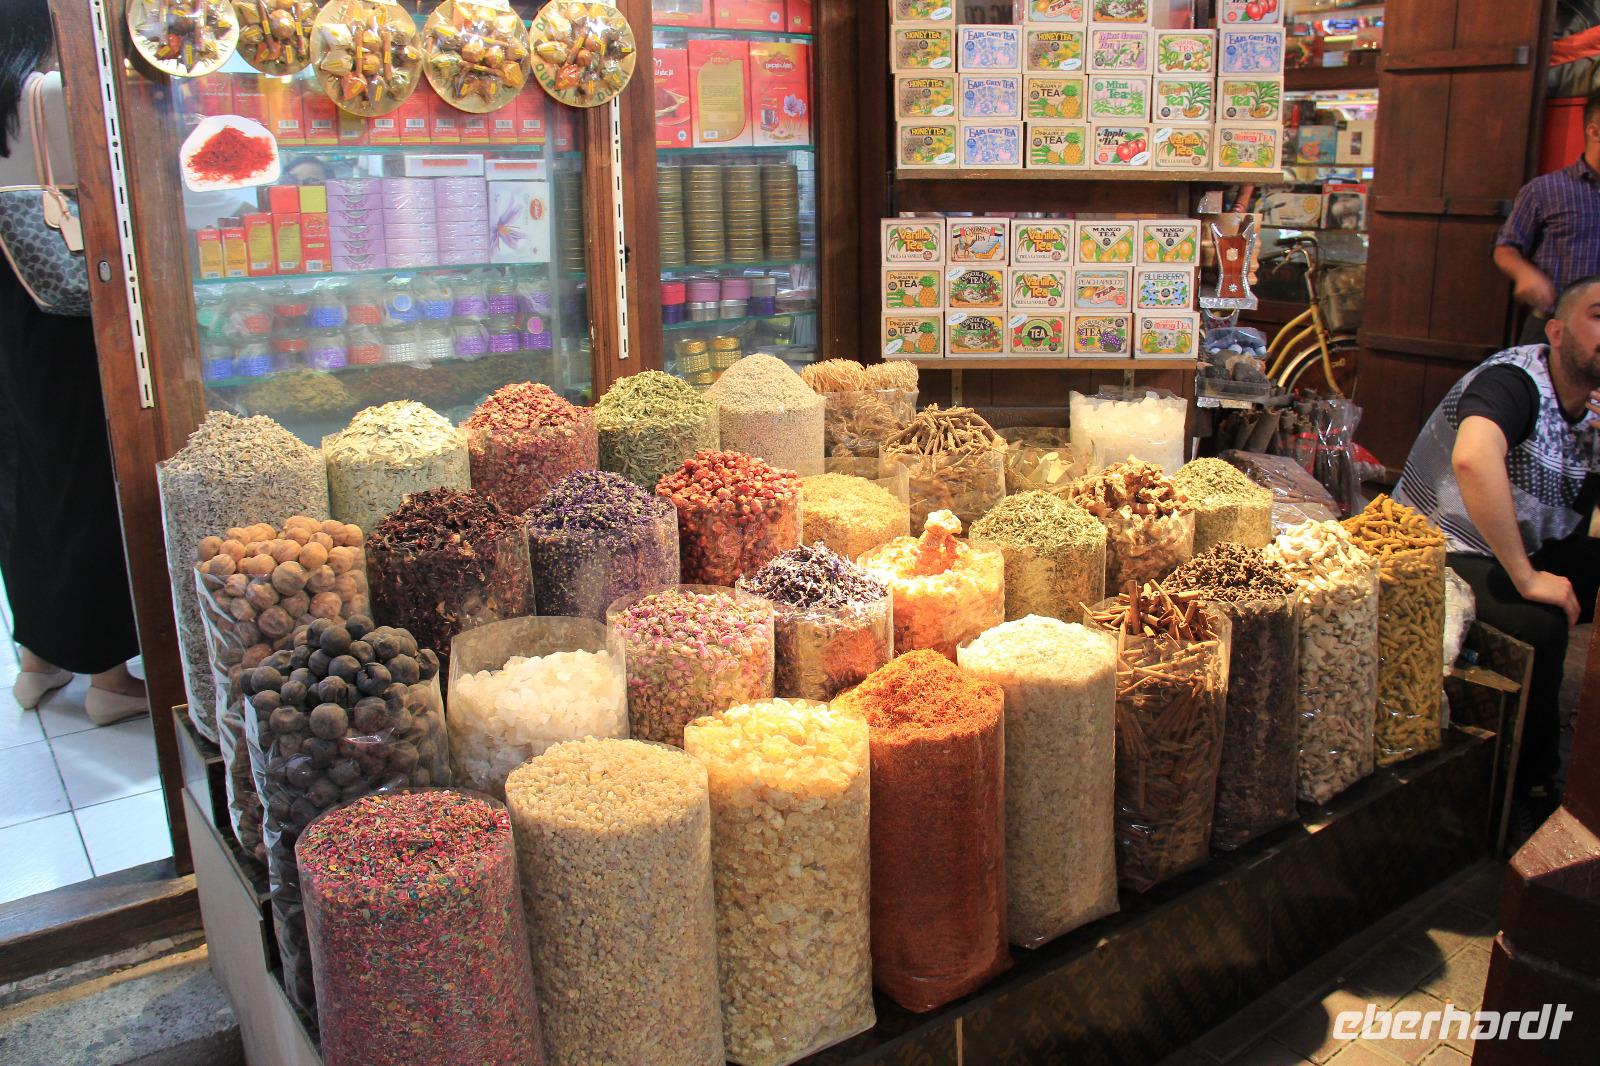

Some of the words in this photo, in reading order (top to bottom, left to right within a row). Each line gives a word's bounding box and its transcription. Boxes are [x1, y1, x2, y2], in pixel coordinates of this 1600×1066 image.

[906, 31, 927, 39] HONEY
[928, 31, 941, 39] TEA
[967, 30, 985, 41] EARL
[1003, 31, 1015, 41] TEA
[1038, 33, 1059, 41] HONEY
[1060, 33, 1073, 41] TEA
[1229, 35, 1248, 44] EARL
[1266, 35, 1278, 44] TEA
[908, 80, 929, 88] HONEY
[931, 80, 945, 88] TEA
[967, 80, 985, 89] EARL
[1003, 80, 1015, 89] TEA
[1105, 80, 1129, 89] Mint
[1041, 89, 1060, 97] TEA
[1107, 89, 1129, 99] Tea
[968, 128, 986, 138] EARL
[1004, 128, 1016, 137] TEA
[1100, 128, 1127, 138] Apple
[1043, 136, 1063, 144] TEA
[1169, 133, 1201, 146] Vanilla
[1175, 145, 1193, 156] Tea
[899, 228, 931, 242] Vanilla
[1028, 228, 1060, 242] Vanilla
[905, 240, 923, 252] Tea
[1034, 240, 1053, 252] Tea
[961, 270, 993, 282] CHOCOLATE
[1023, 274, 1056, 288] Vanilla
[1144, 273, 1185, 281] BLUEBERRY
[898, 279, 918, 287] TEA
[1031, 286, 1049, 298] Tea
[898, 326, 918, 334] TEA
[970, 322, 985, 330] TEA
[1030, 328, 1047, 338] TEA
[1084, 328, 1101, 337] TEA
